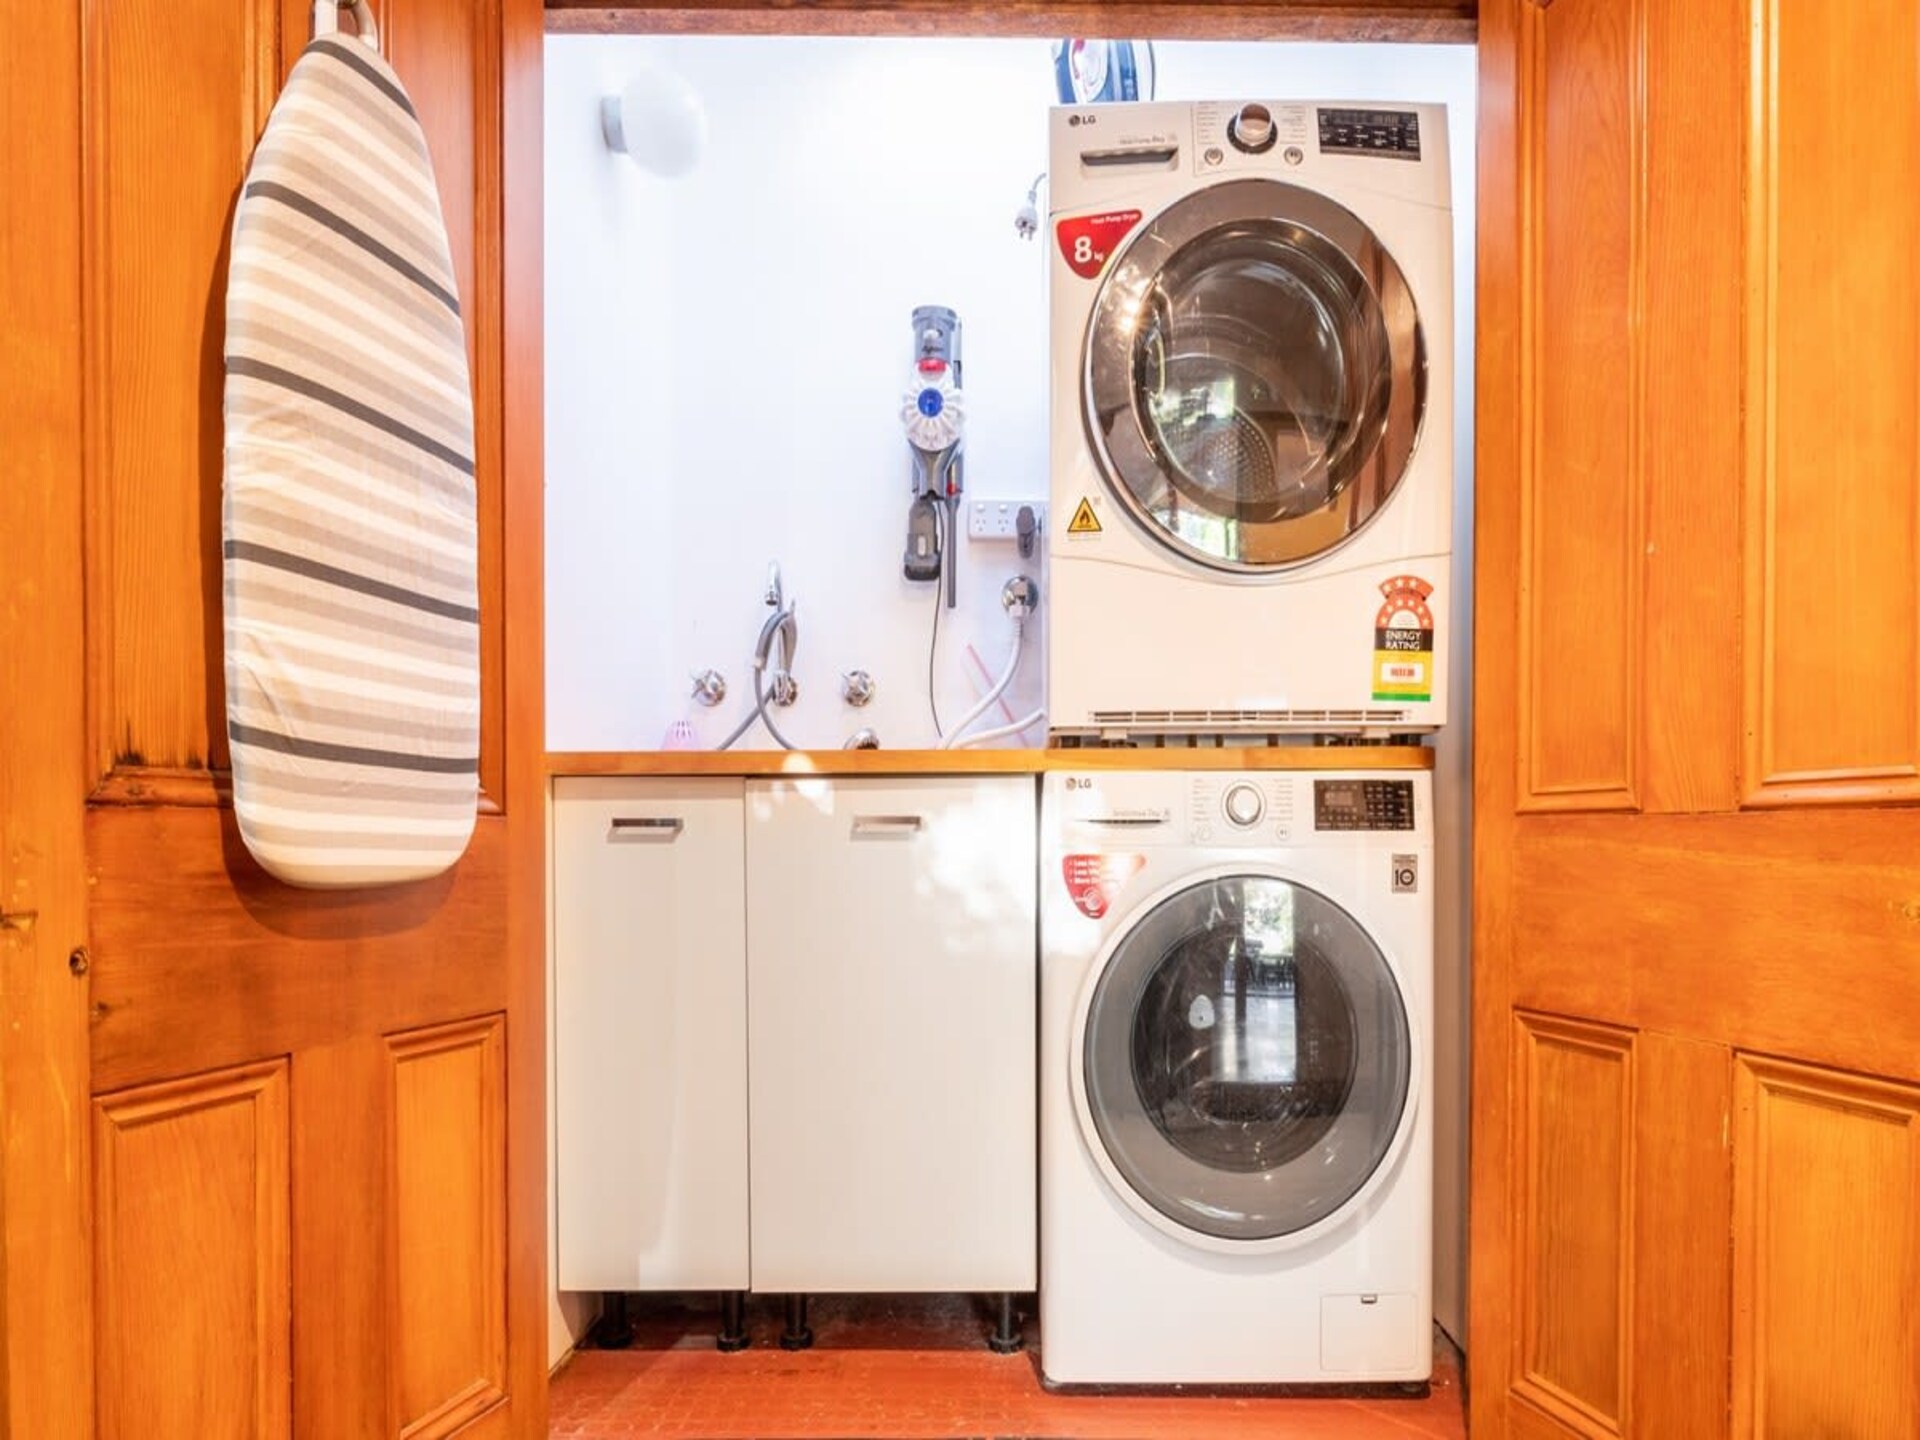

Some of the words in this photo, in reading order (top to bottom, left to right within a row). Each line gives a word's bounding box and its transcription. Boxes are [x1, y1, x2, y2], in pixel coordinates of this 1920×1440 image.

[1075, 235, 1092, 263] 8
[1386, 630, 1421, 641] ENERGY
[1386, 641, 1420, 651] RATING
[1395, 869, 1415, 886] 10
